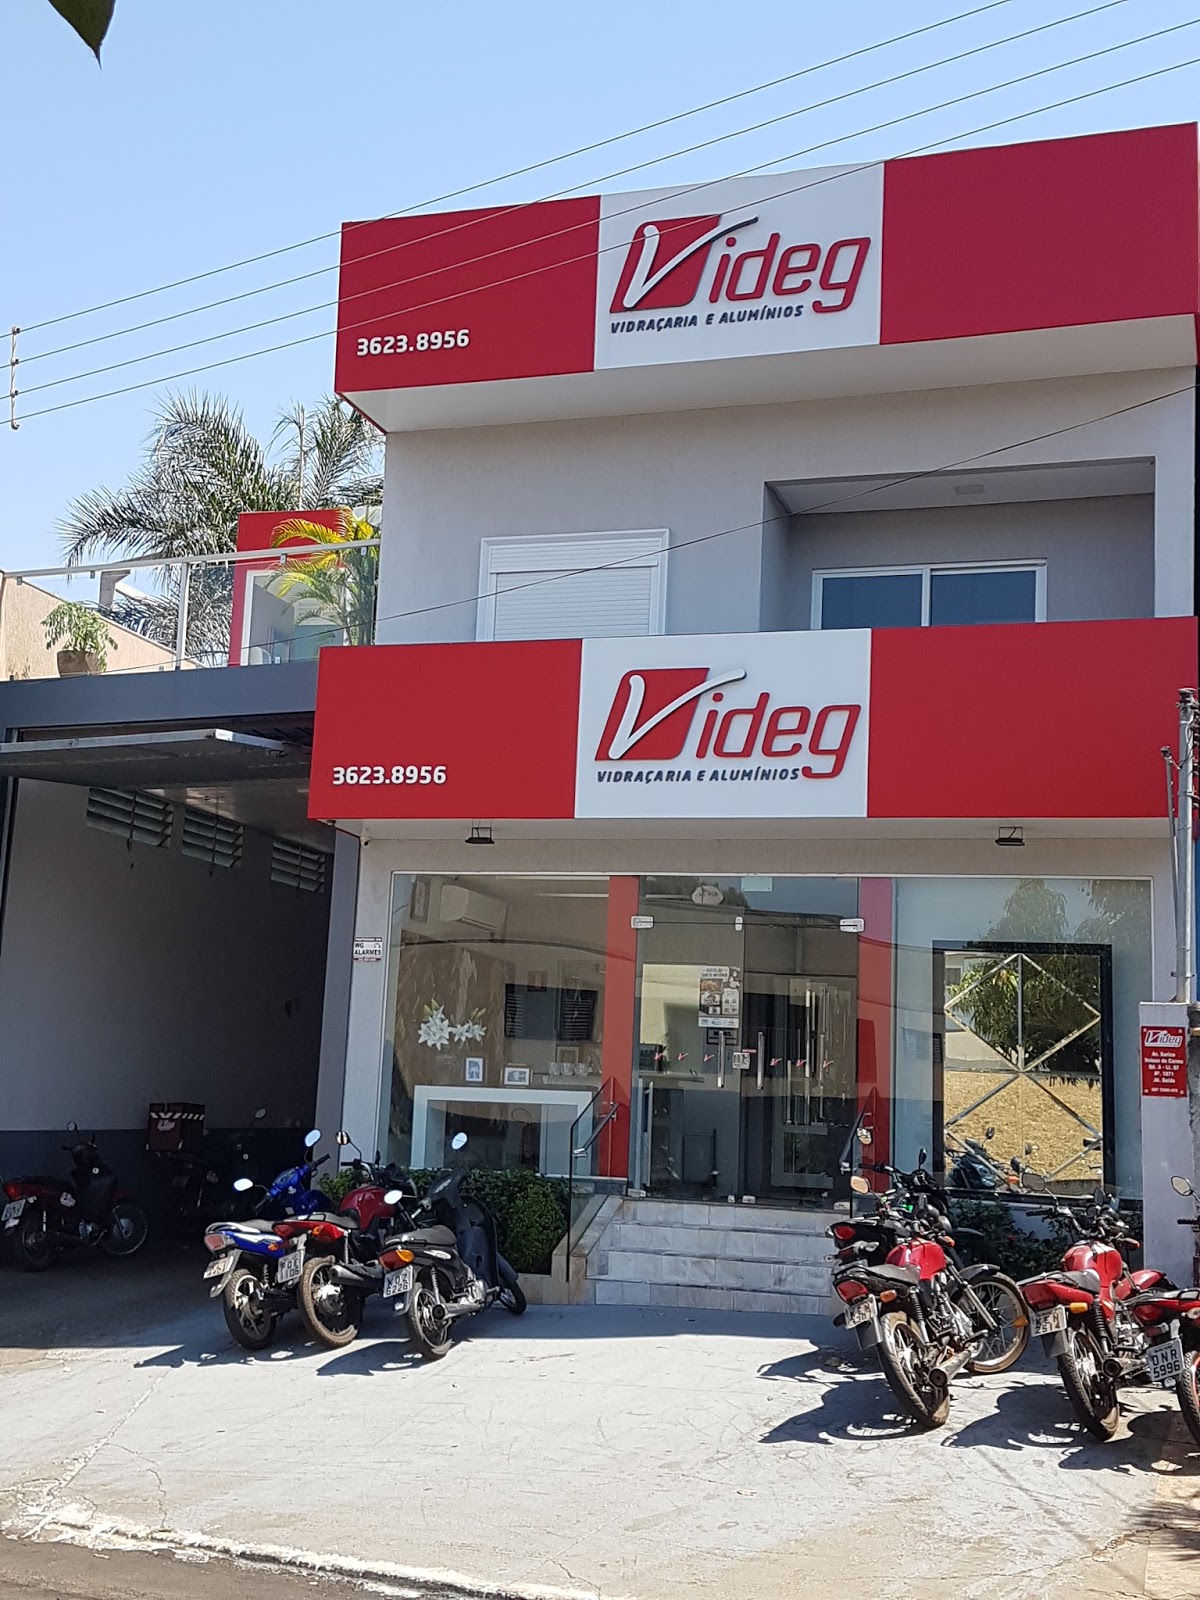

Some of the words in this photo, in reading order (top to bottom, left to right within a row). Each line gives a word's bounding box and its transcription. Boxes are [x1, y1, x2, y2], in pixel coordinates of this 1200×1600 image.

[610, 214, 871, 313] Videg
[611, 316, 697, 333] VIDRAÇARIA
[706, 314, 714, 325] E
[719, 305, 804, 324] ALUMÍNIOS
[357, 329, 470, 356] 3623.8956
[595, 668, 861, 779] Videg
[333, 766, 447, 785] 3623.8956
[597, 770, 691, 784] VIDRAÇARIA
[697, 770, 705, 781] E
[709, 766, 800, 781] ALUMÍNIOS
[1035, 1312, 1060, 1326] KEN
[1153, 1360, 1181, 1378] 5996
